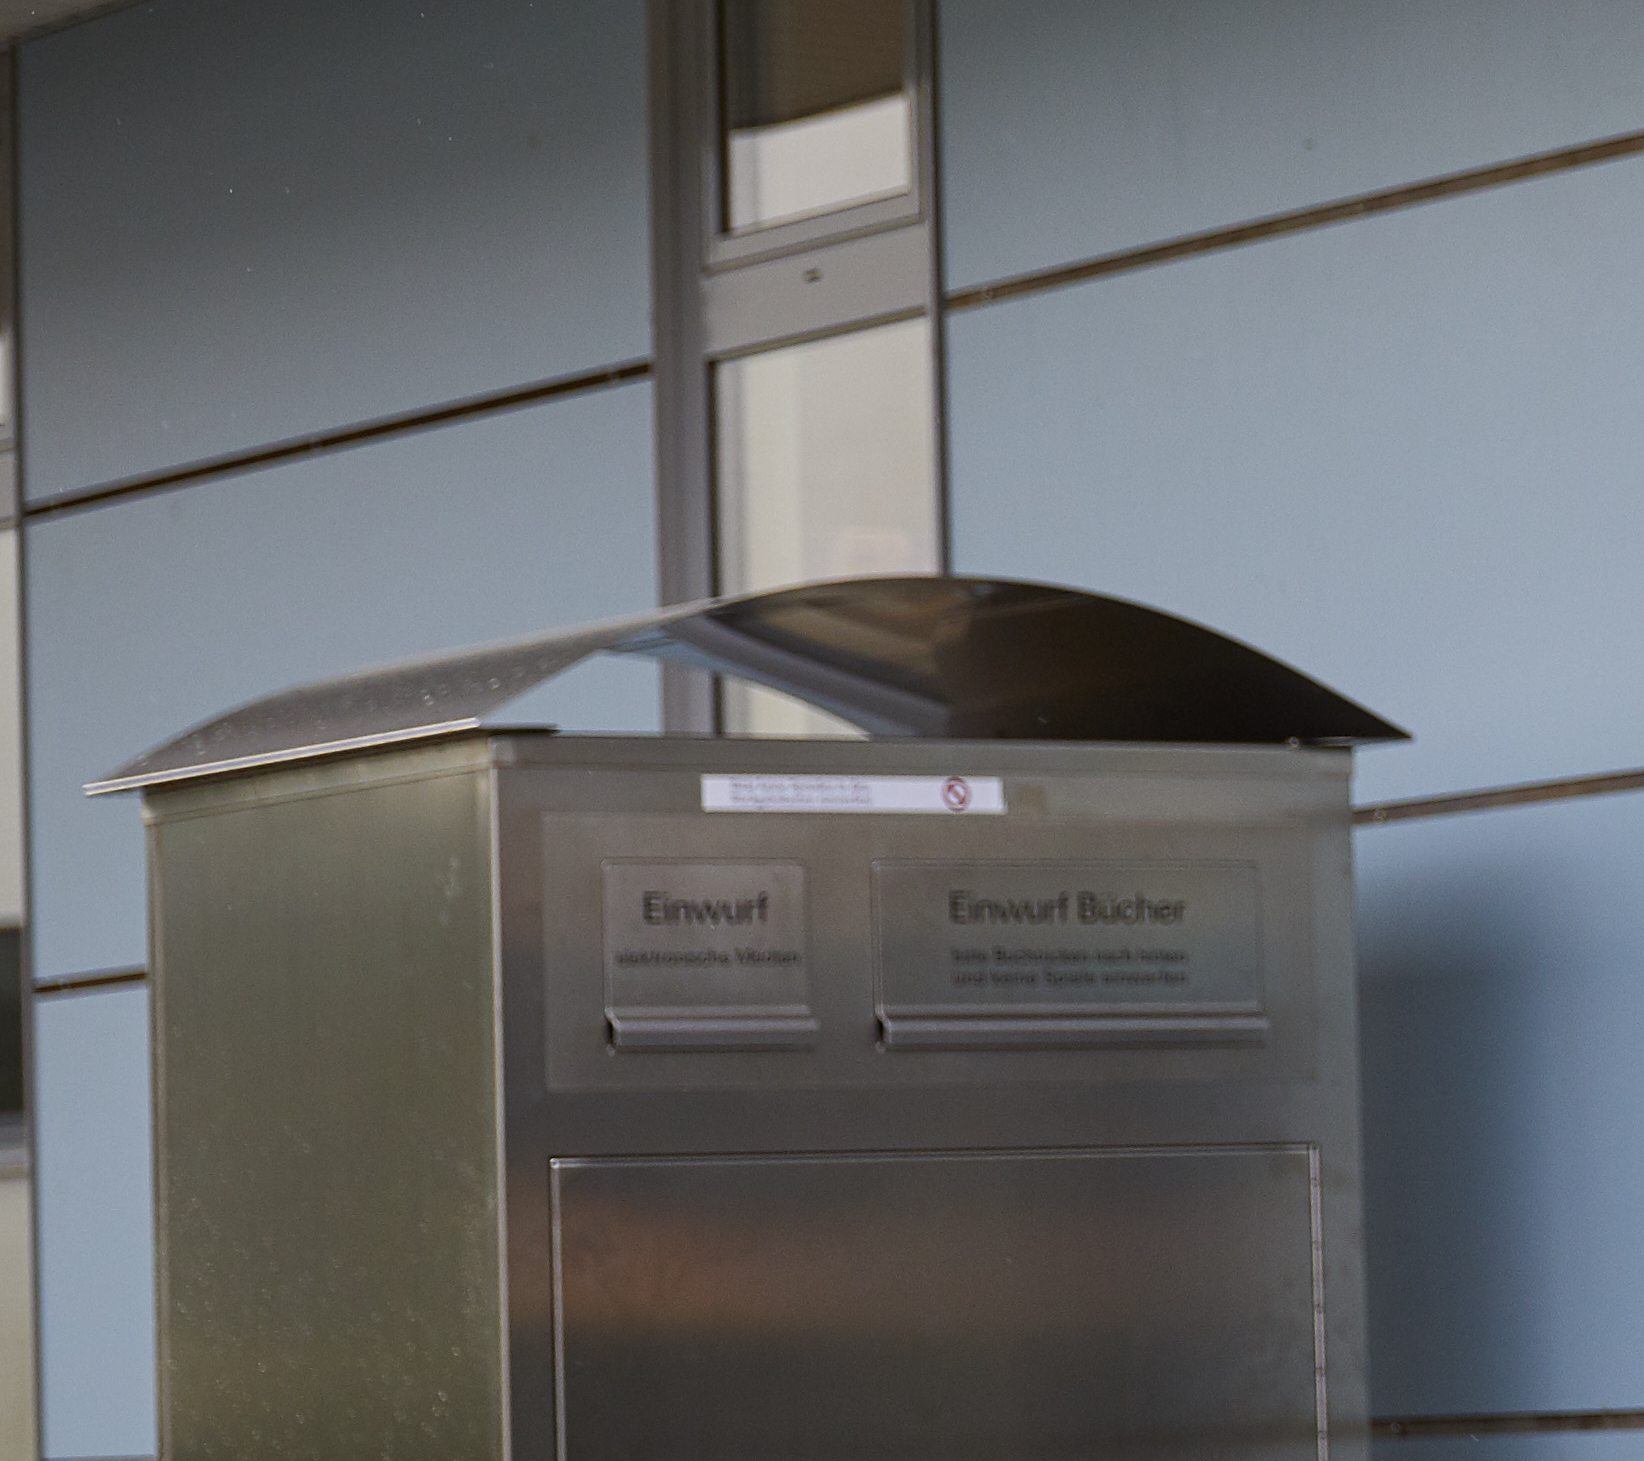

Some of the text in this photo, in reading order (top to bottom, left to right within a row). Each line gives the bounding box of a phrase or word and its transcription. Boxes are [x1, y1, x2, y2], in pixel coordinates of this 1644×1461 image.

[642, 891, 768, 926] Einwurf
[948, 889, 1185, 925] Einwurf Bücher
